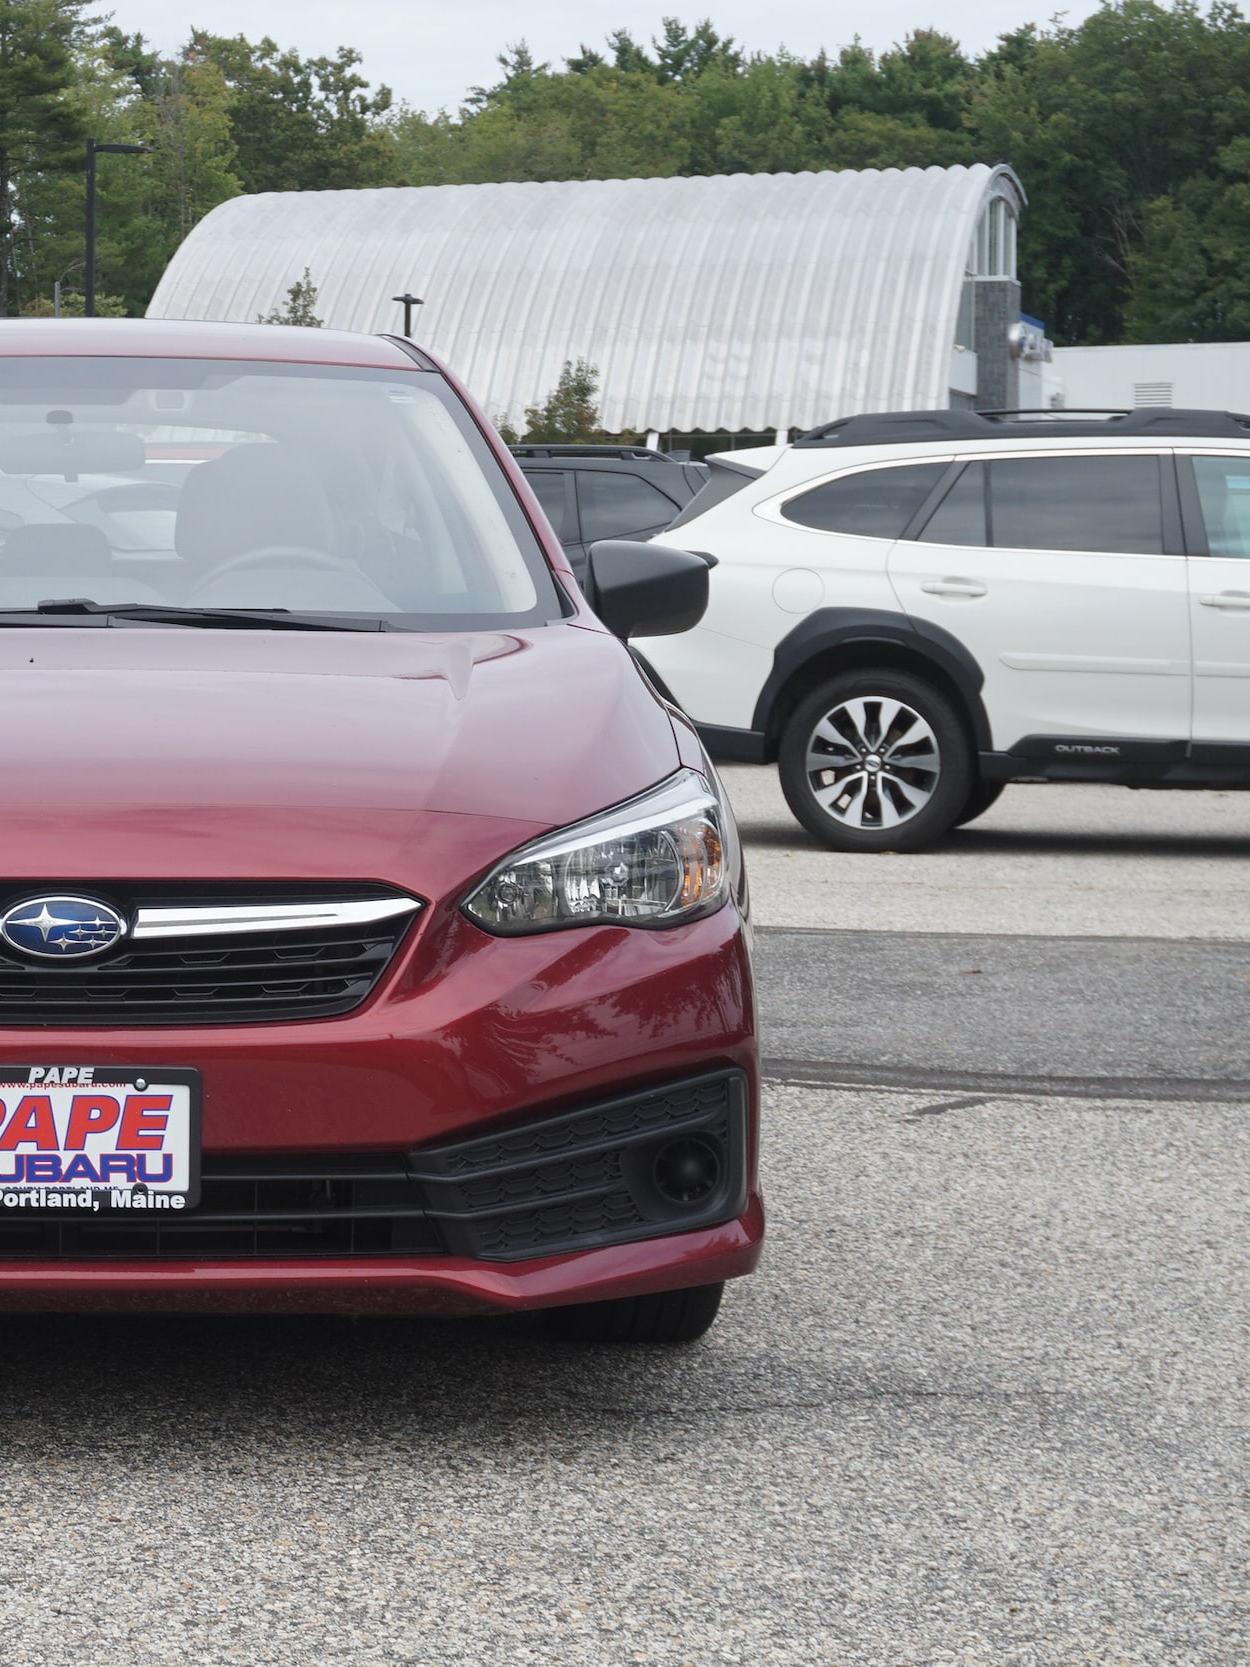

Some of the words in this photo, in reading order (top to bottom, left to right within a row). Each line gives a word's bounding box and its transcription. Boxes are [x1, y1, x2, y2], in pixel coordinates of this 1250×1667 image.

[1055, 745, 1119, 754] OUTBACK
[28, 1067, 94, 1084] PAPE
[110, 1190, 186, 1209] Maine
